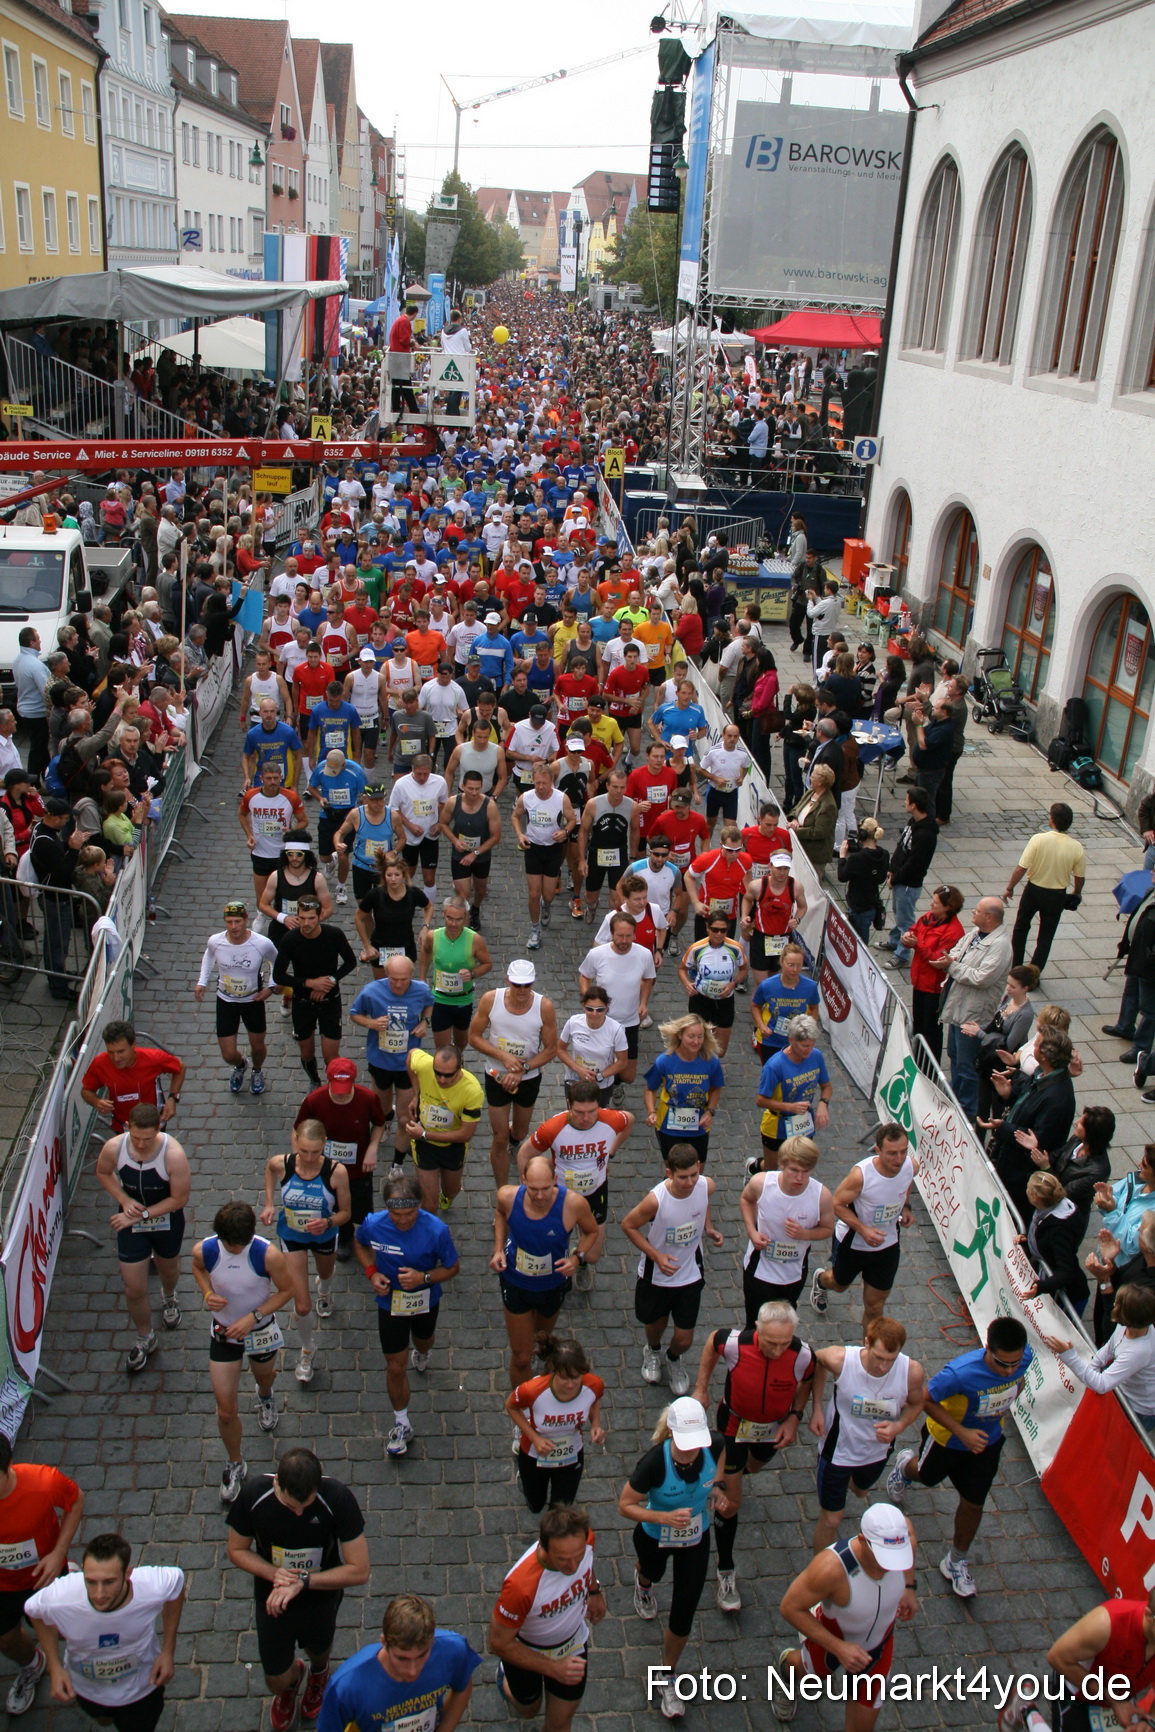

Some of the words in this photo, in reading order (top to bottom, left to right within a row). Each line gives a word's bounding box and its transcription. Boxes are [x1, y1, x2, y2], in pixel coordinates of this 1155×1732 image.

[788, 143, 903, 171] BAROWSK
[788, 164, 854, 178] Veranstaltungs-
[857, 171, 874, 179] und
[387, 197, 396, 238] HOTE
[783, 267, 888, 288] www.barowski-ag
[315, 425, 327, 439] A
[33, 450, 72, 461] Service
[94, 449, 119, 459] Miet-
[121, 449, 128, 459] &
[131, 448, 183, 459] Serviceline:
[185, 448, 210, 458] 09181
[211, 448, 233, 457] 6352
[323, 448, 344, 457] 6352
[609, 457, 621, 471] A
[255, 472, 290, 481] Schnupper-
[253, 807, 285, 816] MERZ
[829, 912, 839, 925] Wir
[822, 966, 832, 981] Wir
[233, 984, 248, 992] 737
[388, 1039, 404, 1047] 635
[792, 1068, 821, 1083] NEUMARKTER
[429, 1106, 439, 1114] Dirk
[431, 1113, 449, 1124] 209
[676, 1115, 696, 1123] 3905
[794, 1119, 811, 1131] 3906
[332, 1149, 354, 1158] 3609
[559, 1140, 607, 1155] MERZ
[577, 1178, 595, 1187] 472
[677, 1228, 697, 1241] 3577
[775, 1249, 800, 1258] 3085
[527, 1262, 547, 1270] 212
[405, 1299, 424, 1309] 249
[256, 1332, 280, 1347] 2810
[986, 1376, 1025, 1395] NEUMARKT
[864, 1405, 892, 1417] 3575
[543, 1411, 584, 1425] MERZ
[1013, 1398, 1040, 1442] verleih
[549, 1445, 575, 1458] 2926
[672, 1525, 700, 1539] 3230
[0, 1550, 32, 1564] 2206
[284, 1550, 307, 1559] Martin
[289, 1559, 314, 1570] 360
[540, 1567, 593, 1615] MERZ
[371, 1711, 385, 1721] 10.
[397, 1717, 421, 1730] Martin
